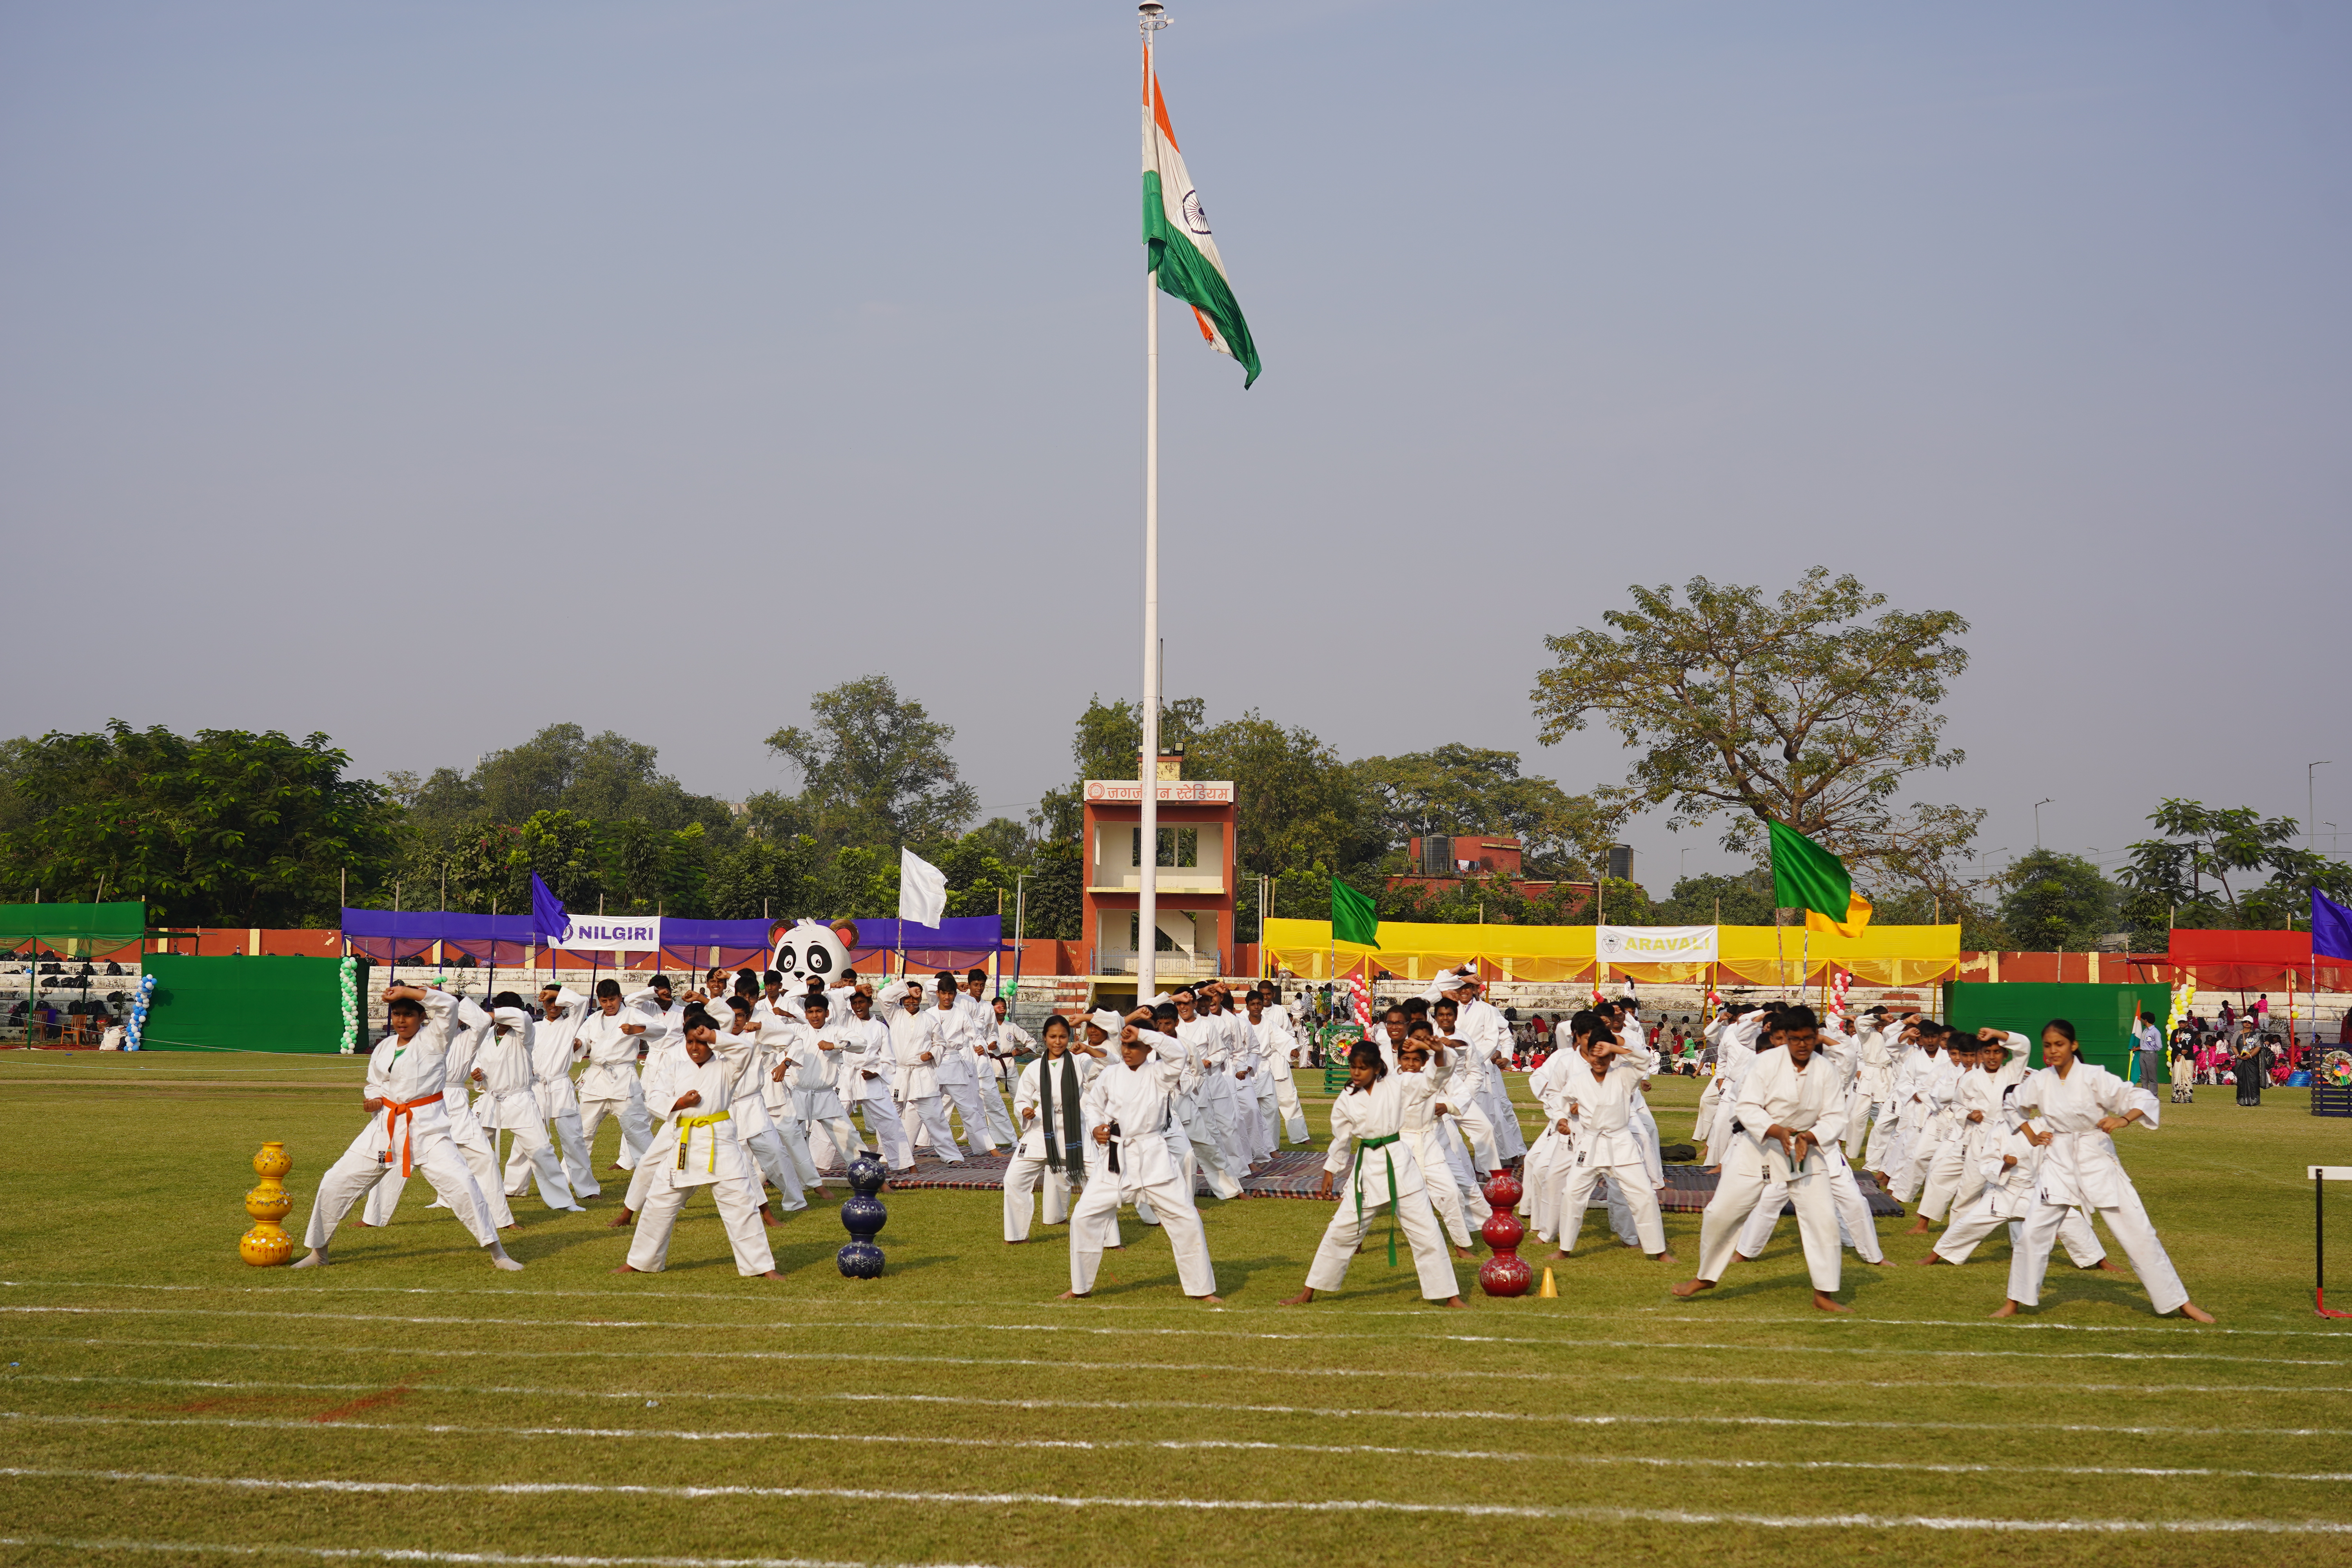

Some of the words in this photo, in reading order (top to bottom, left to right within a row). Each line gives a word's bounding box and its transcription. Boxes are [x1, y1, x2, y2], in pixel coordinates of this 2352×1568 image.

[1107, 784, 1172, 799] जगजन
[1176, 784, 1230, 800] स्टेडियम
[579, 926, 653, 940] NILGIRI
[1624, 938, 1709, 950] ARAVALI
